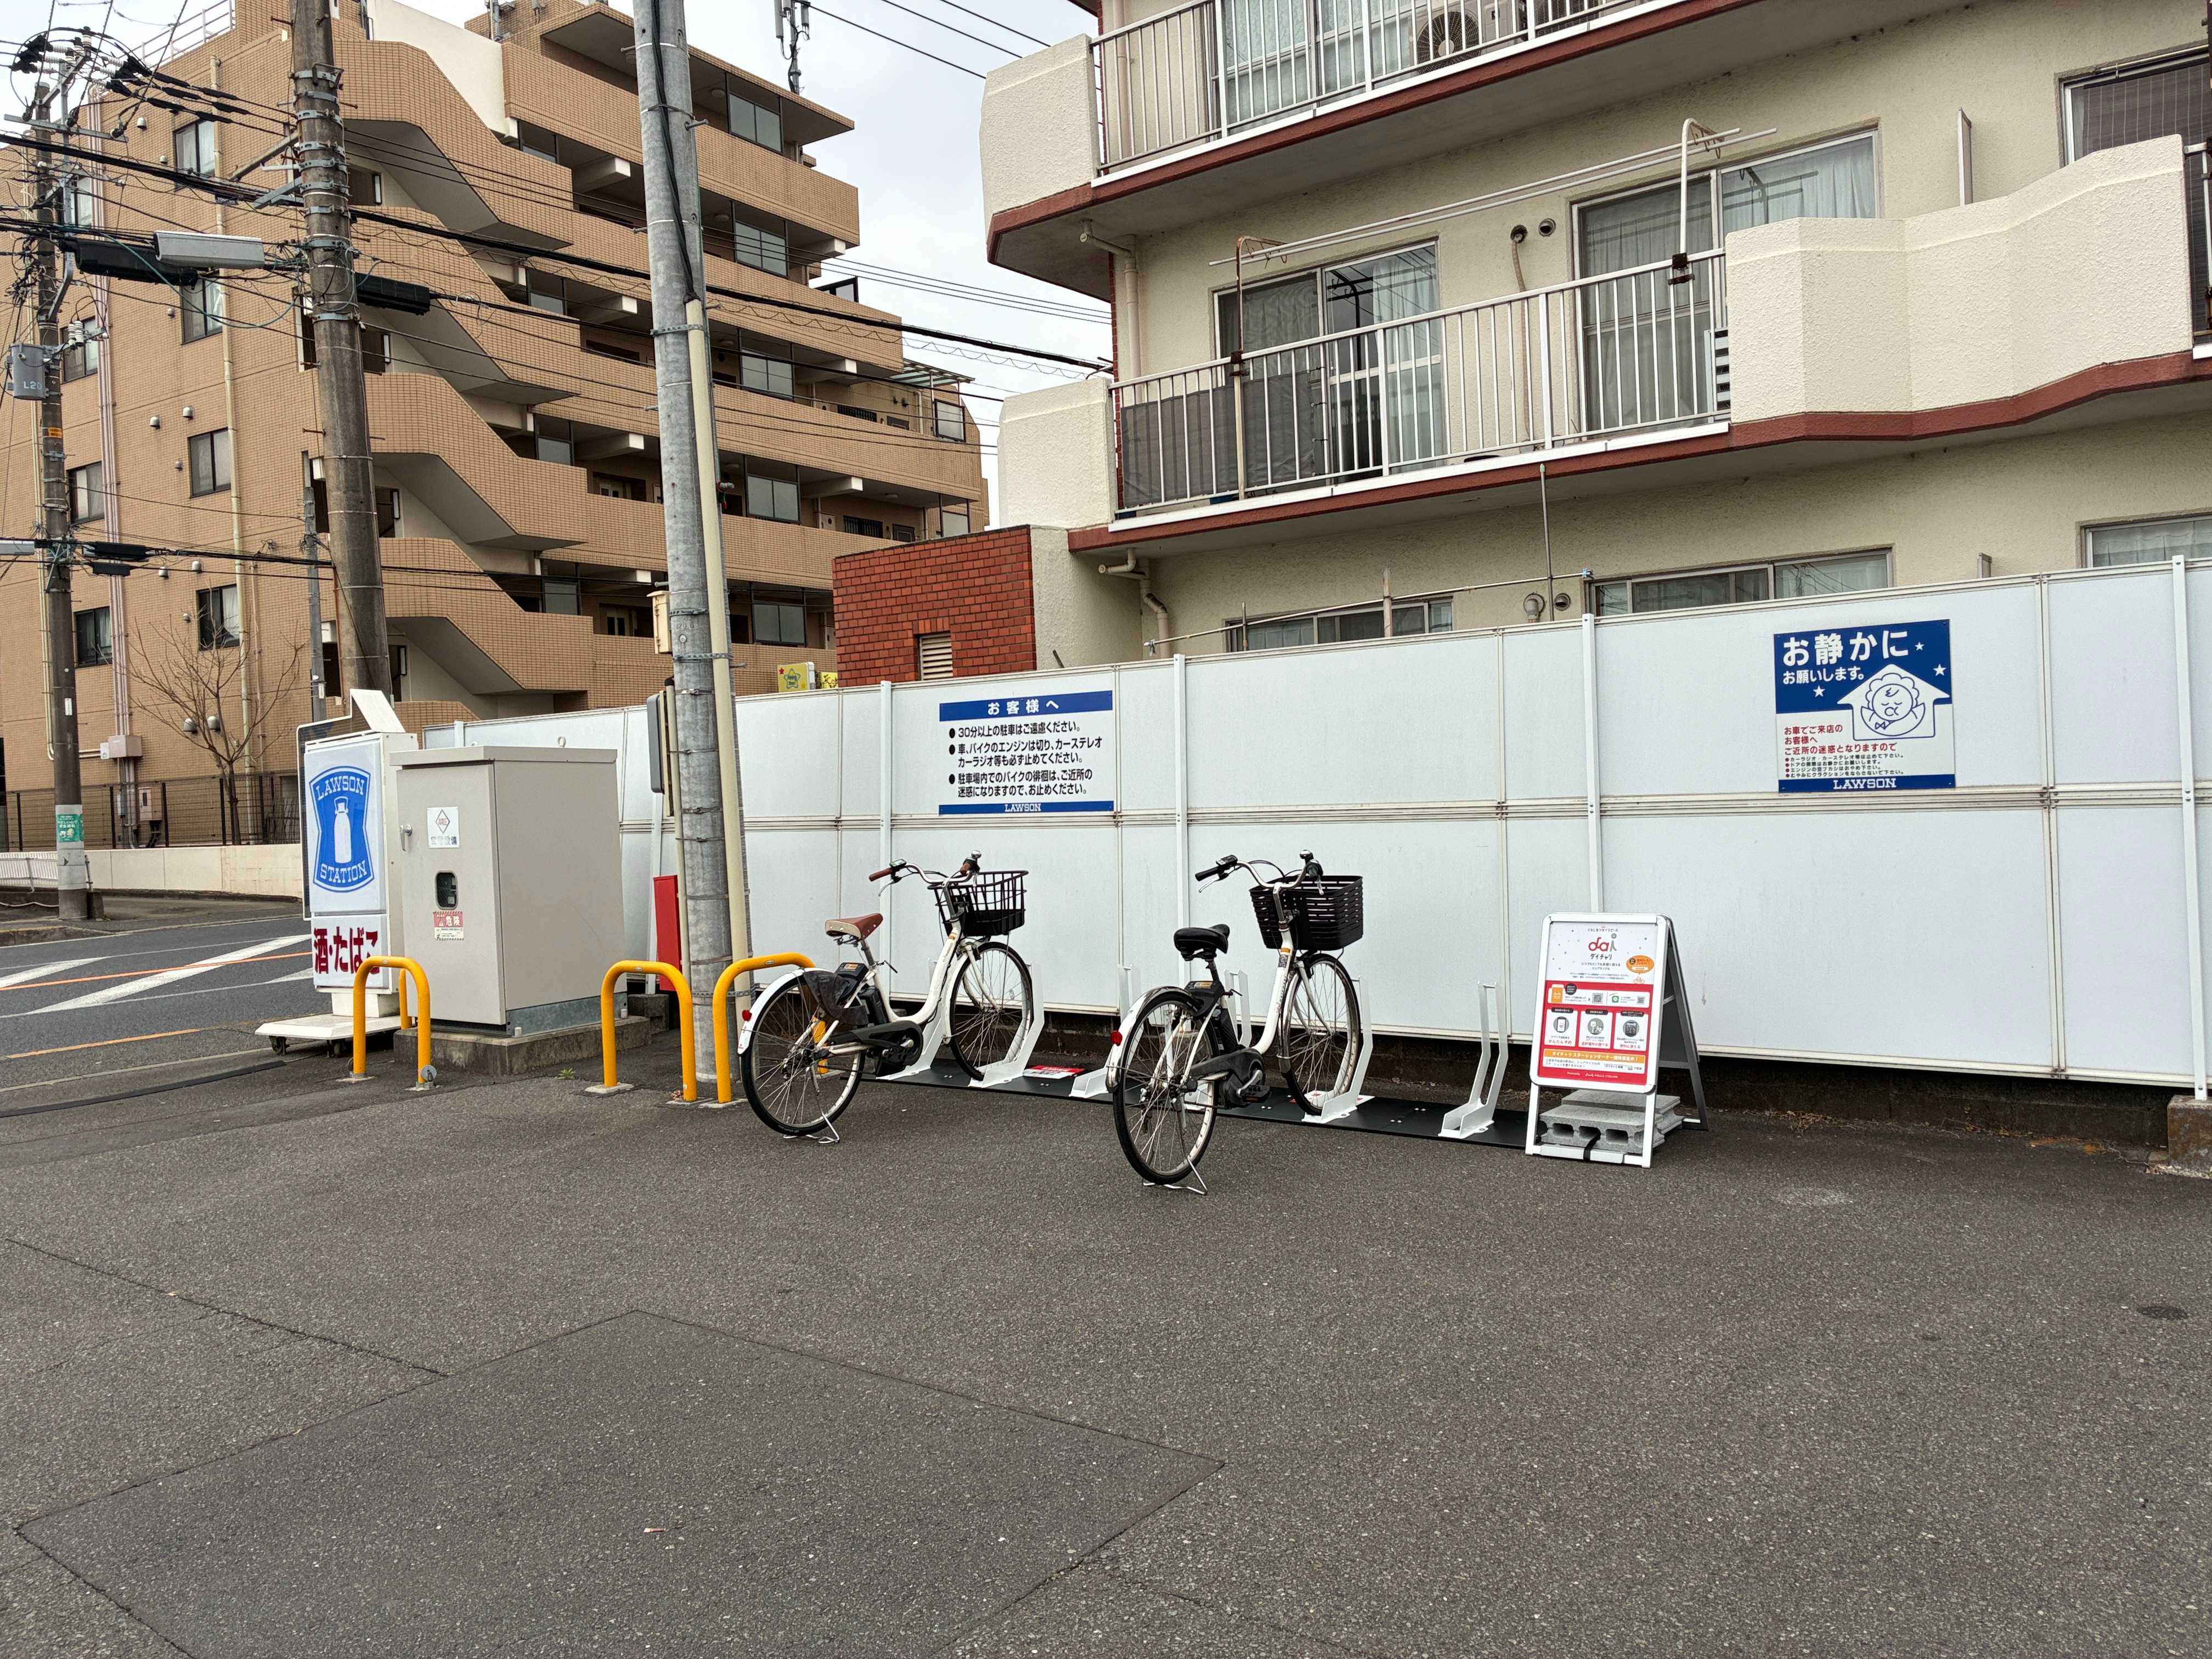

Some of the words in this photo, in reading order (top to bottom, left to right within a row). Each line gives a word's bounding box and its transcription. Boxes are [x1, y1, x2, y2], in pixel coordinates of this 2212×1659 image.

[24, 381, 43, 391] L20
[1783, 630, 1909, 667] お静かに
[1783, 667, 1864, 685] お願いします。
[988, 699, 1059, 715] お客様へ
[958, 721, 1080, 737] 30分以上の駐車はご遠慮ください。
[1785, 724, 1843, 735] お車でご来店の
[958, 737, 1102, 754] 車、バイクのエンジンは切り、カーステレオ
[1785, 736, 1818, 745] お客様へ
[1785, 742, 1897, 755] ご近所の迷惑となりますので
[958, 752, 1083, 768] カーラジオ等も必ず止めてください。
[958, 769, 1092, 785] 駐車場内でのバイクの徘徊は、ご近所の
[1833, 778, 1897, 789] LAWSON
[316, 776, 364, 800] LAWSON
[958, 783, 1086, 798] 迷惑になりますので、お止めください。
[1005, 803, 1041, 812] LAWSON
[320, 860, 367, 883] STATION
[445, 915, 461, 927] 危険
[314, 927, 380, 974] 酒・たばこ
